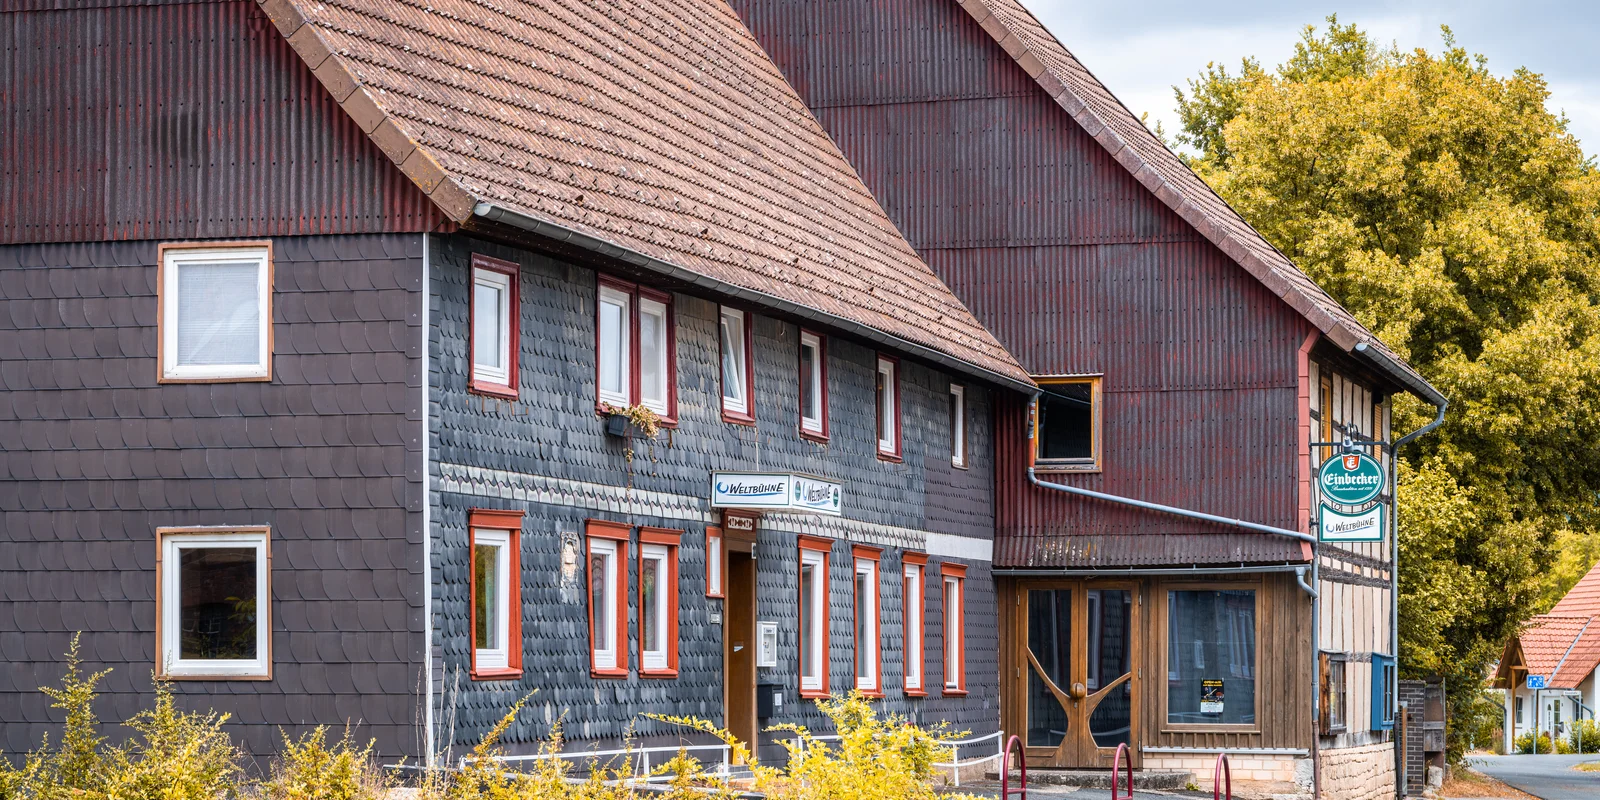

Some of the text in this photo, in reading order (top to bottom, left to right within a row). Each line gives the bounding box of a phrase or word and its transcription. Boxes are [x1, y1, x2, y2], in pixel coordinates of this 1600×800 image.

[1324, 472, 1378, 485] Einbecker
[728, 482, 785, 494] WELTBÜHNE
[1335, 517, 1375, 531] WELTBÜHNE
